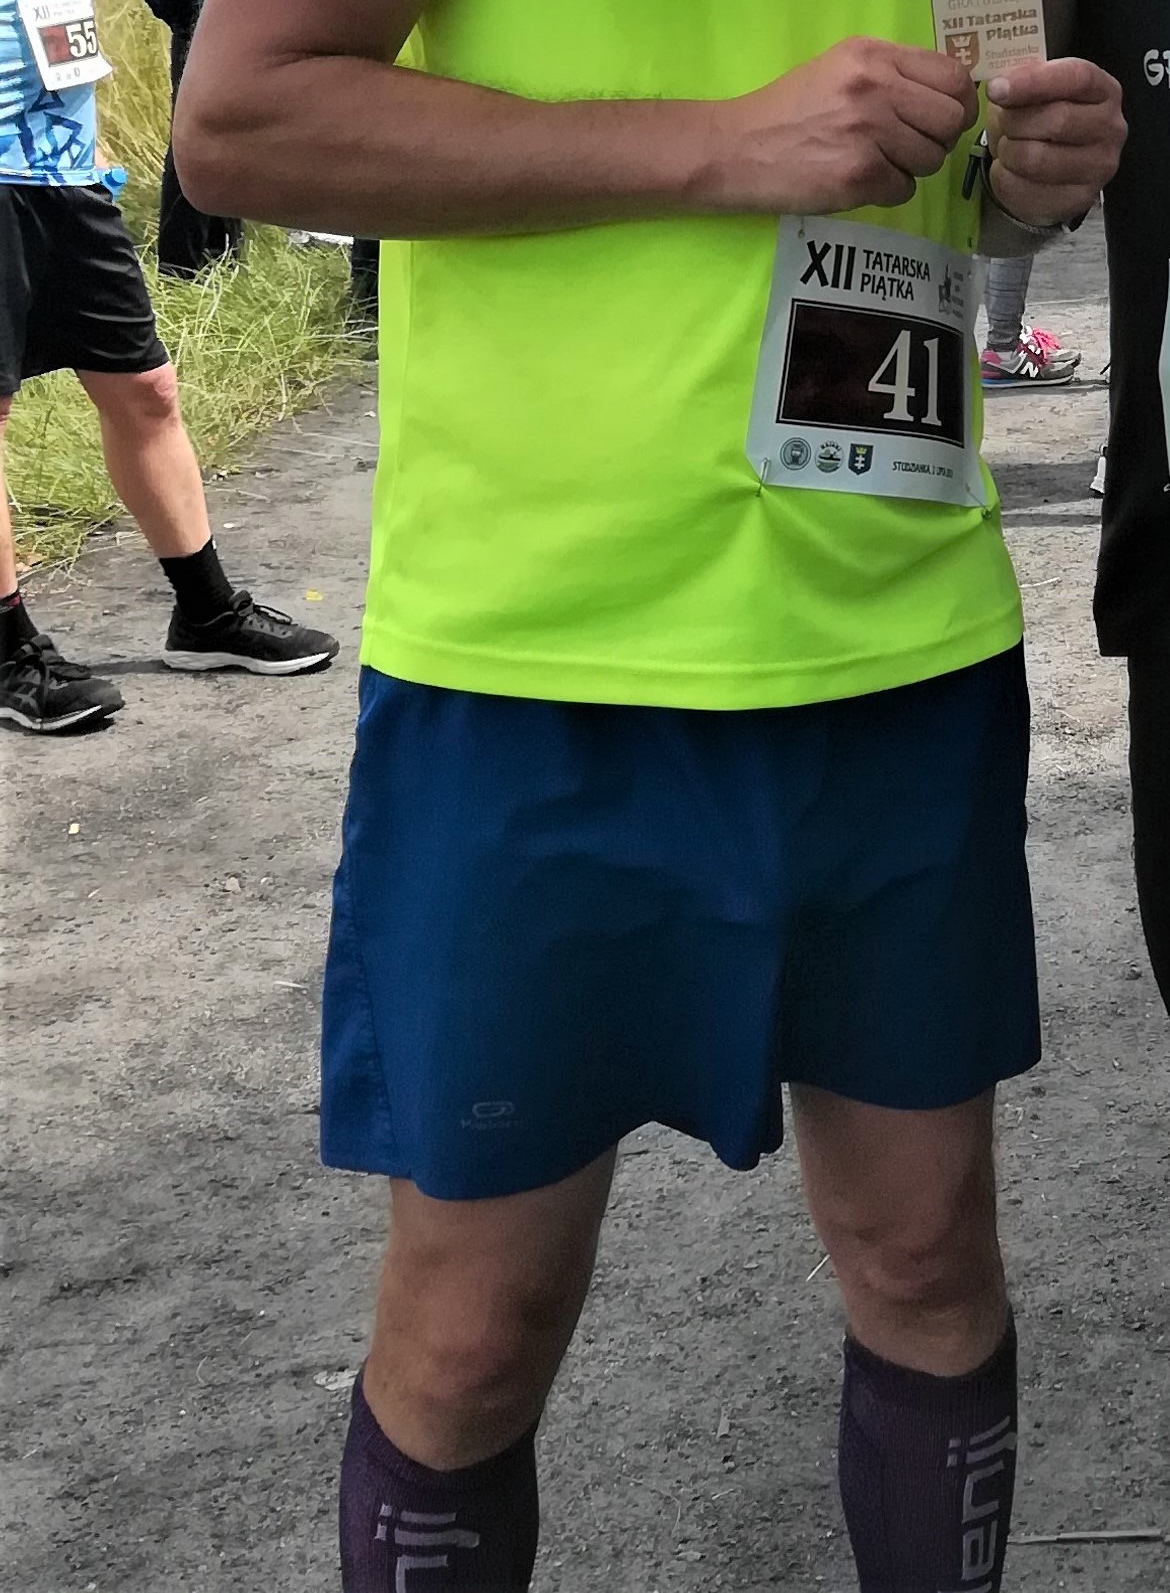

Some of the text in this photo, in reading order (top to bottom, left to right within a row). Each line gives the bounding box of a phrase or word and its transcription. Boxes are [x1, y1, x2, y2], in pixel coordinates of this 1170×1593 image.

[942, 9, 1038, 30] XII Tatarska
[65, 20, 97, 58] 55
[800, 240, 931, 291] XII TATARSKA
[860, 273, 915, 301] PIĄTKA
[868, 329, 942, 426] 41
